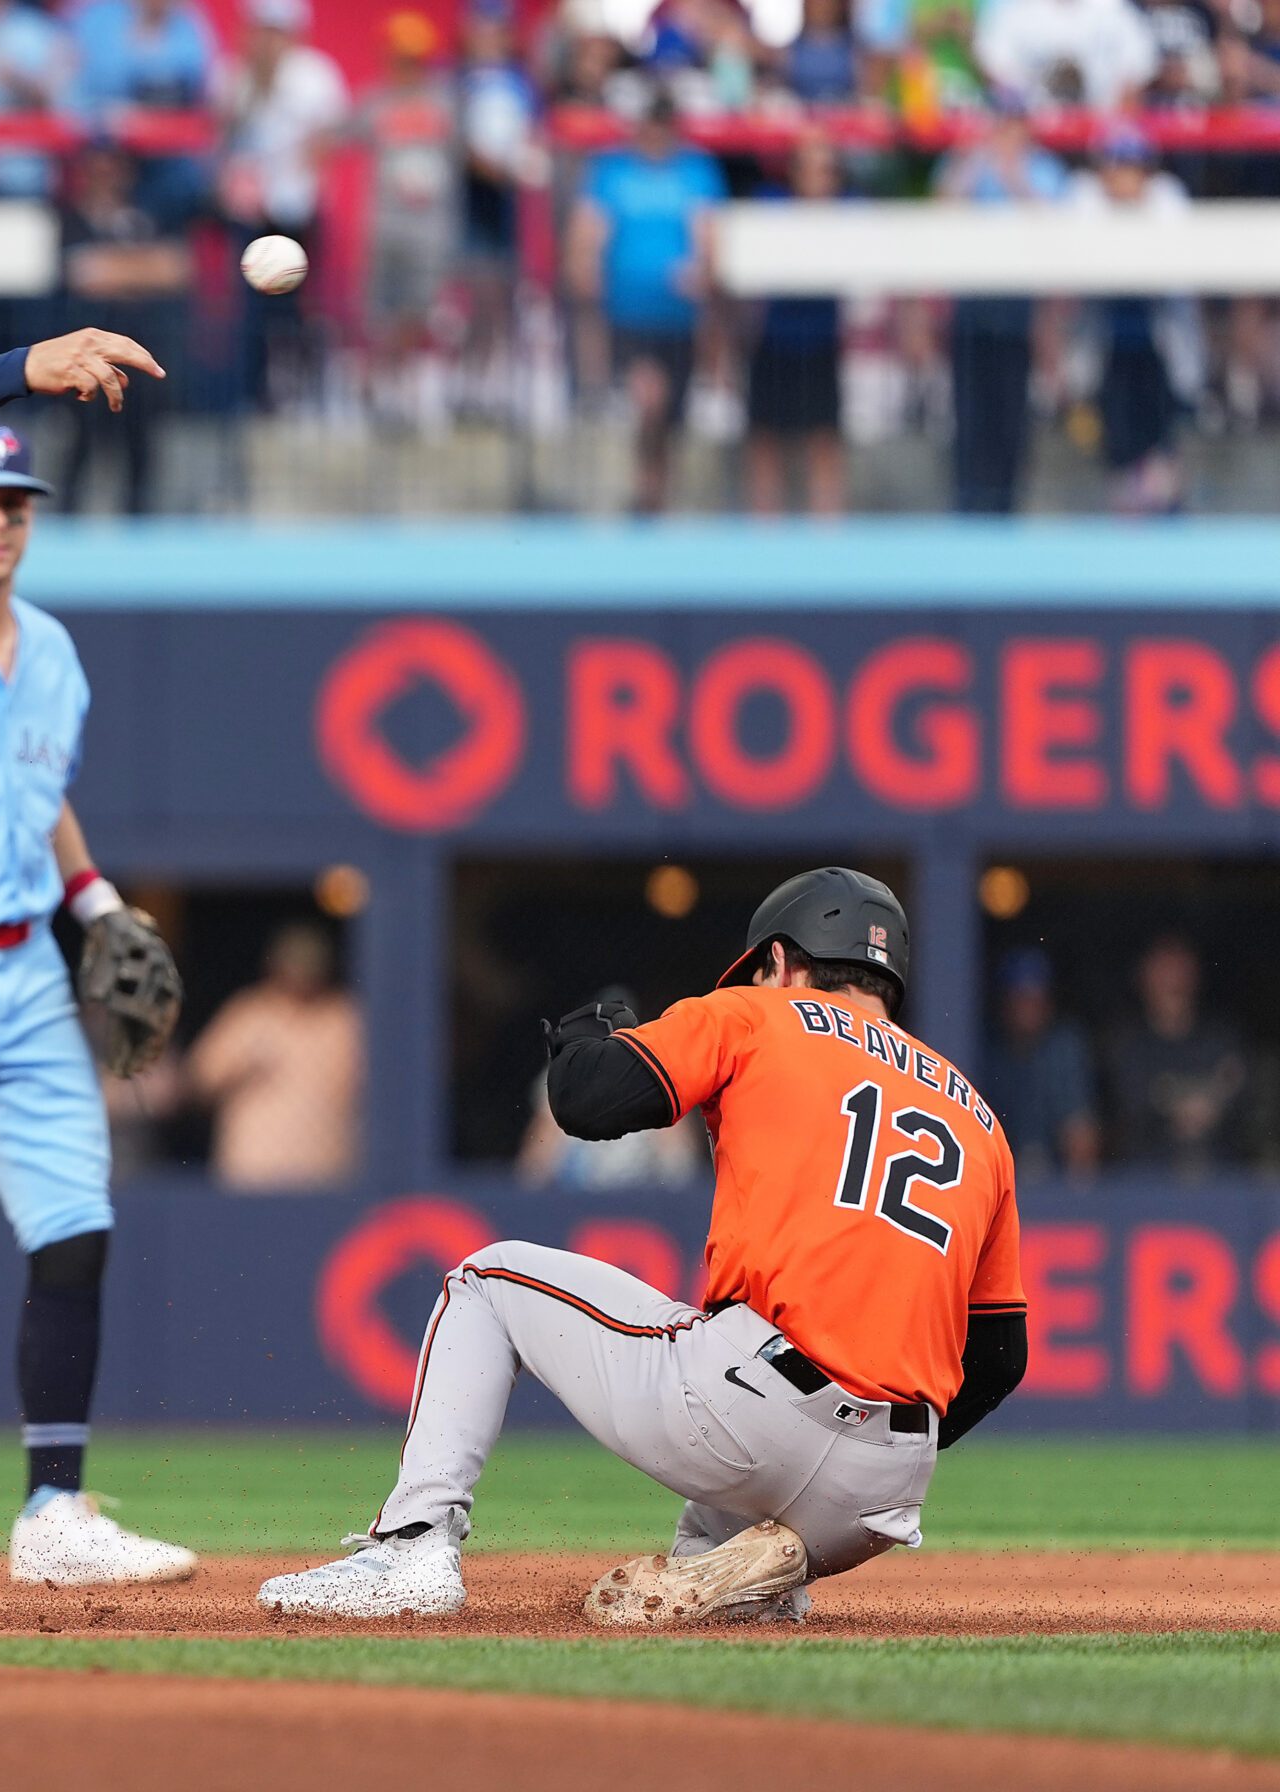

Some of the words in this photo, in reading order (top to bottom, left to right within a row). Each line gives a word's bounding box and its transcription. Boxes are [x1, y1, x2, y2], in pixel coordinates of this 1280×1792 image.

[16, 727, 71, 776] JAY
[565, 637, 1280, 811] ROGER
[869, 925, 887, 949] 12
[789, 1000, 996, 1135] BEAVERS
[833, 1080, 965, 1256] 12
